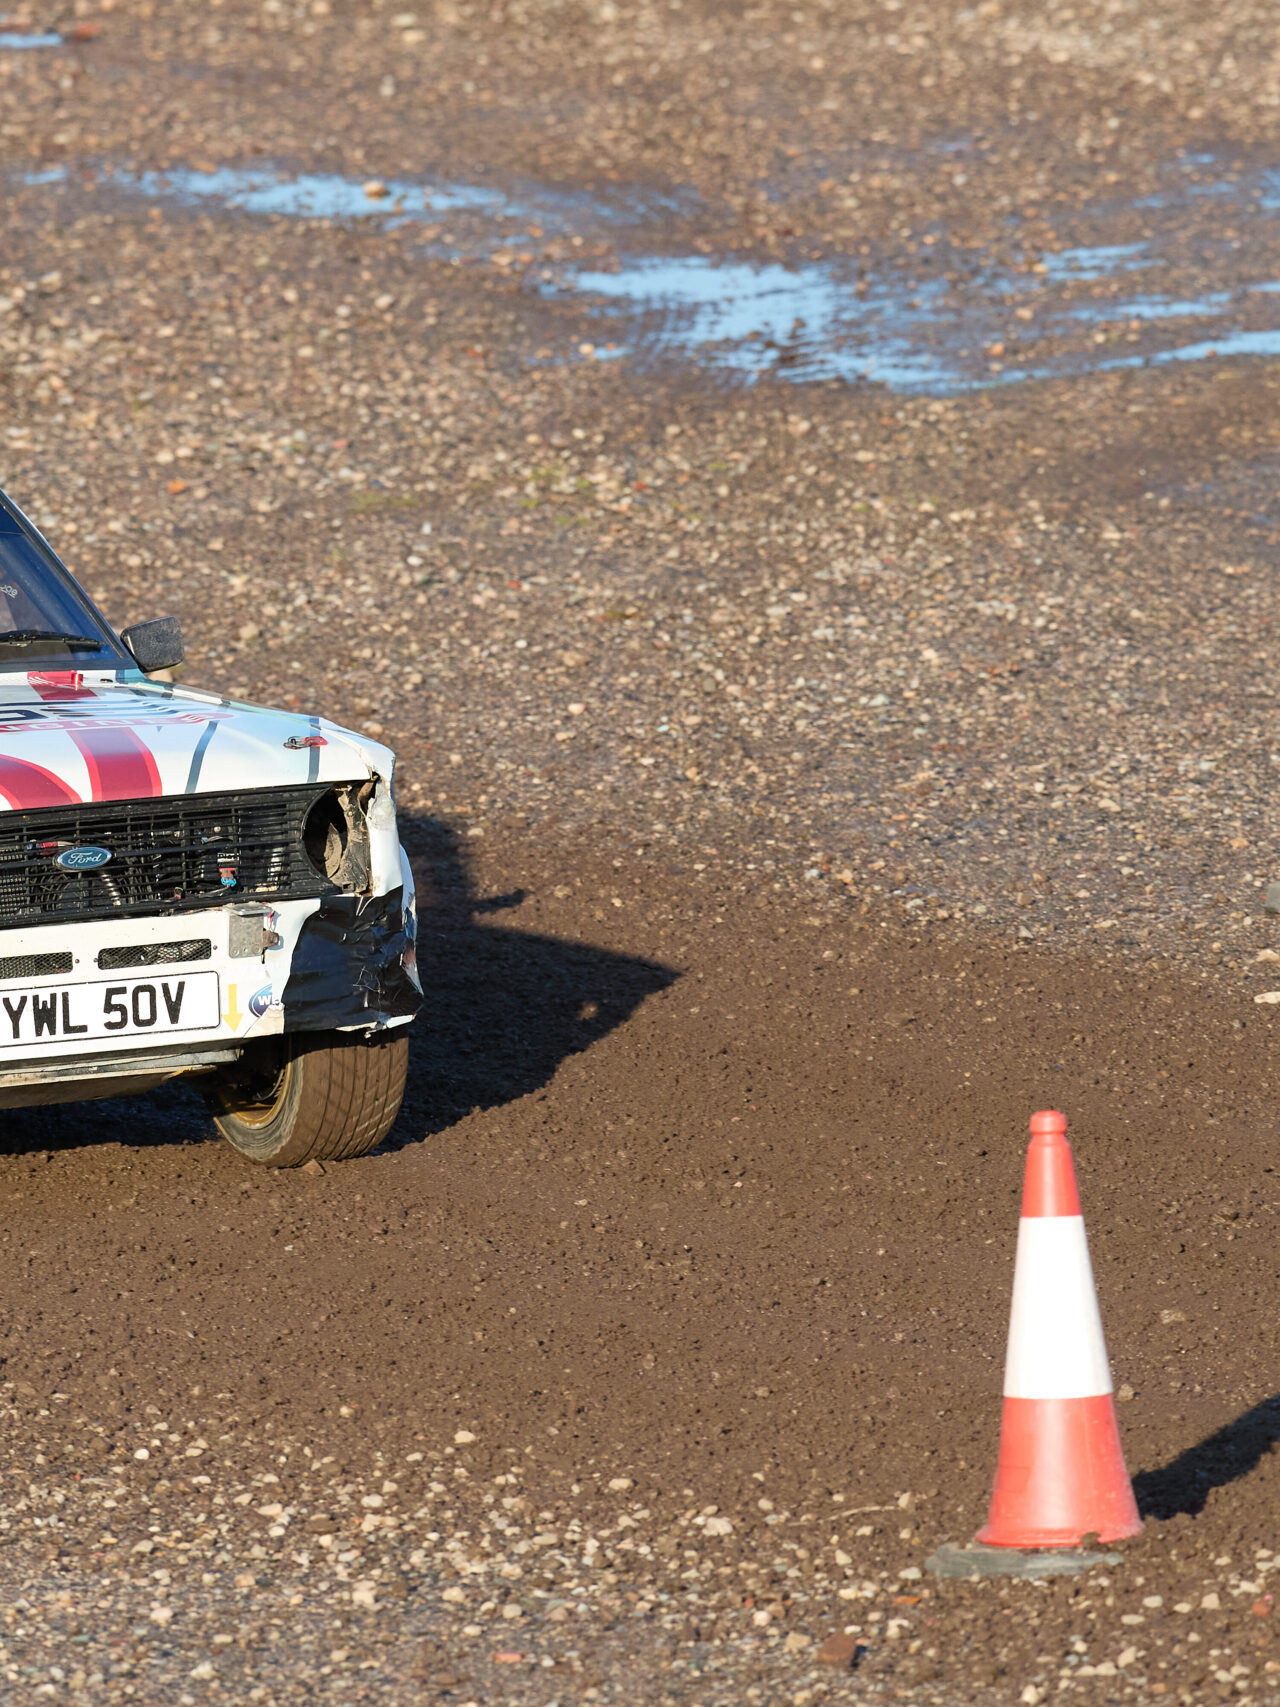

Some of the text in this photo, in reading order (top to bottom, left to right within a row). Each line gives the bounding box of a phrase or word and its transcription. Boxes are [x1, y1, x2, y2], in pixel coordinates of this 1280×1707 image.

[68, 852, 102, 865] Ford
[2, 981, 186, 1039] YWL 50V
